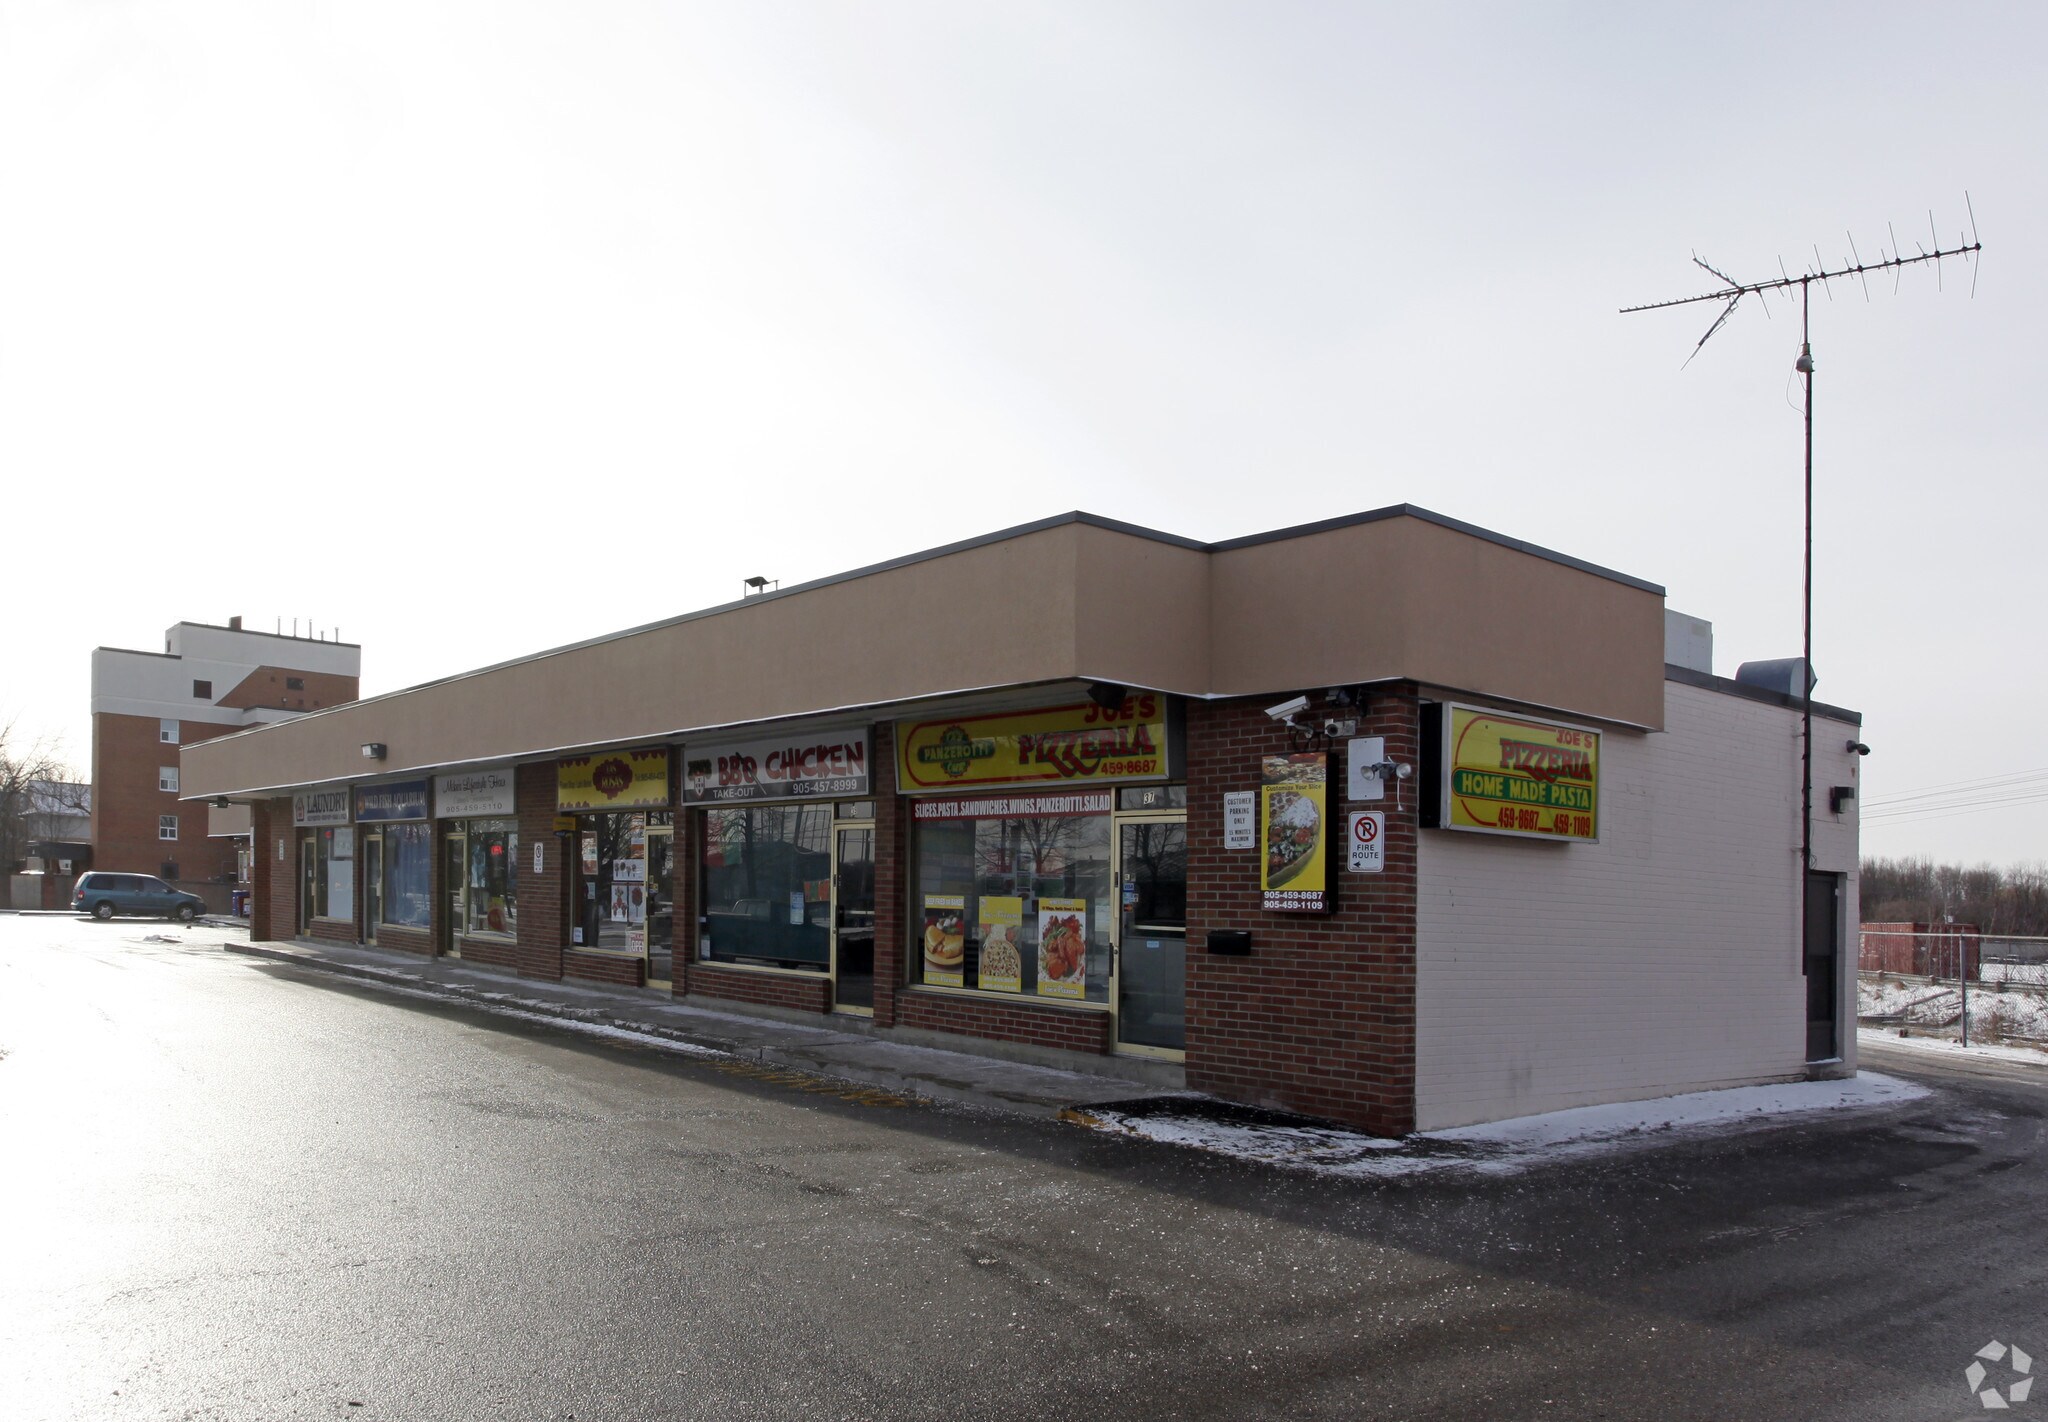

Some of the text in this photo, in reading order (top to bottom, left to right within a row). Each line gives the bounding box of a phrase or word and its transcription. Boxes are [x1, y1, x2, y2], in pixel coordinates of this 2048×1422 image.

[1556, 729, 1593, 749] JOE'S
[924, 743, 989, 760] PANZEROTTI
[1019, 723, 1156, 777] PIZZERIA
[717, 741, 865, 786] BBQ CHICKEN
[1500, 738, 1592, 783] PIZZERIA
[713, 779, 858, 799] TAKE-OUT 905-457-8999
[1461, 773, 1590, 808] HOME MADE PASTA
[307, 792, 347, 813] LAUNDRY
[393, 792, 425, 808] AQUARIUM
[1264, 891, 1323, 899] 905-459-8687
[1264, 900, 1323, 909] 905-459-1109
